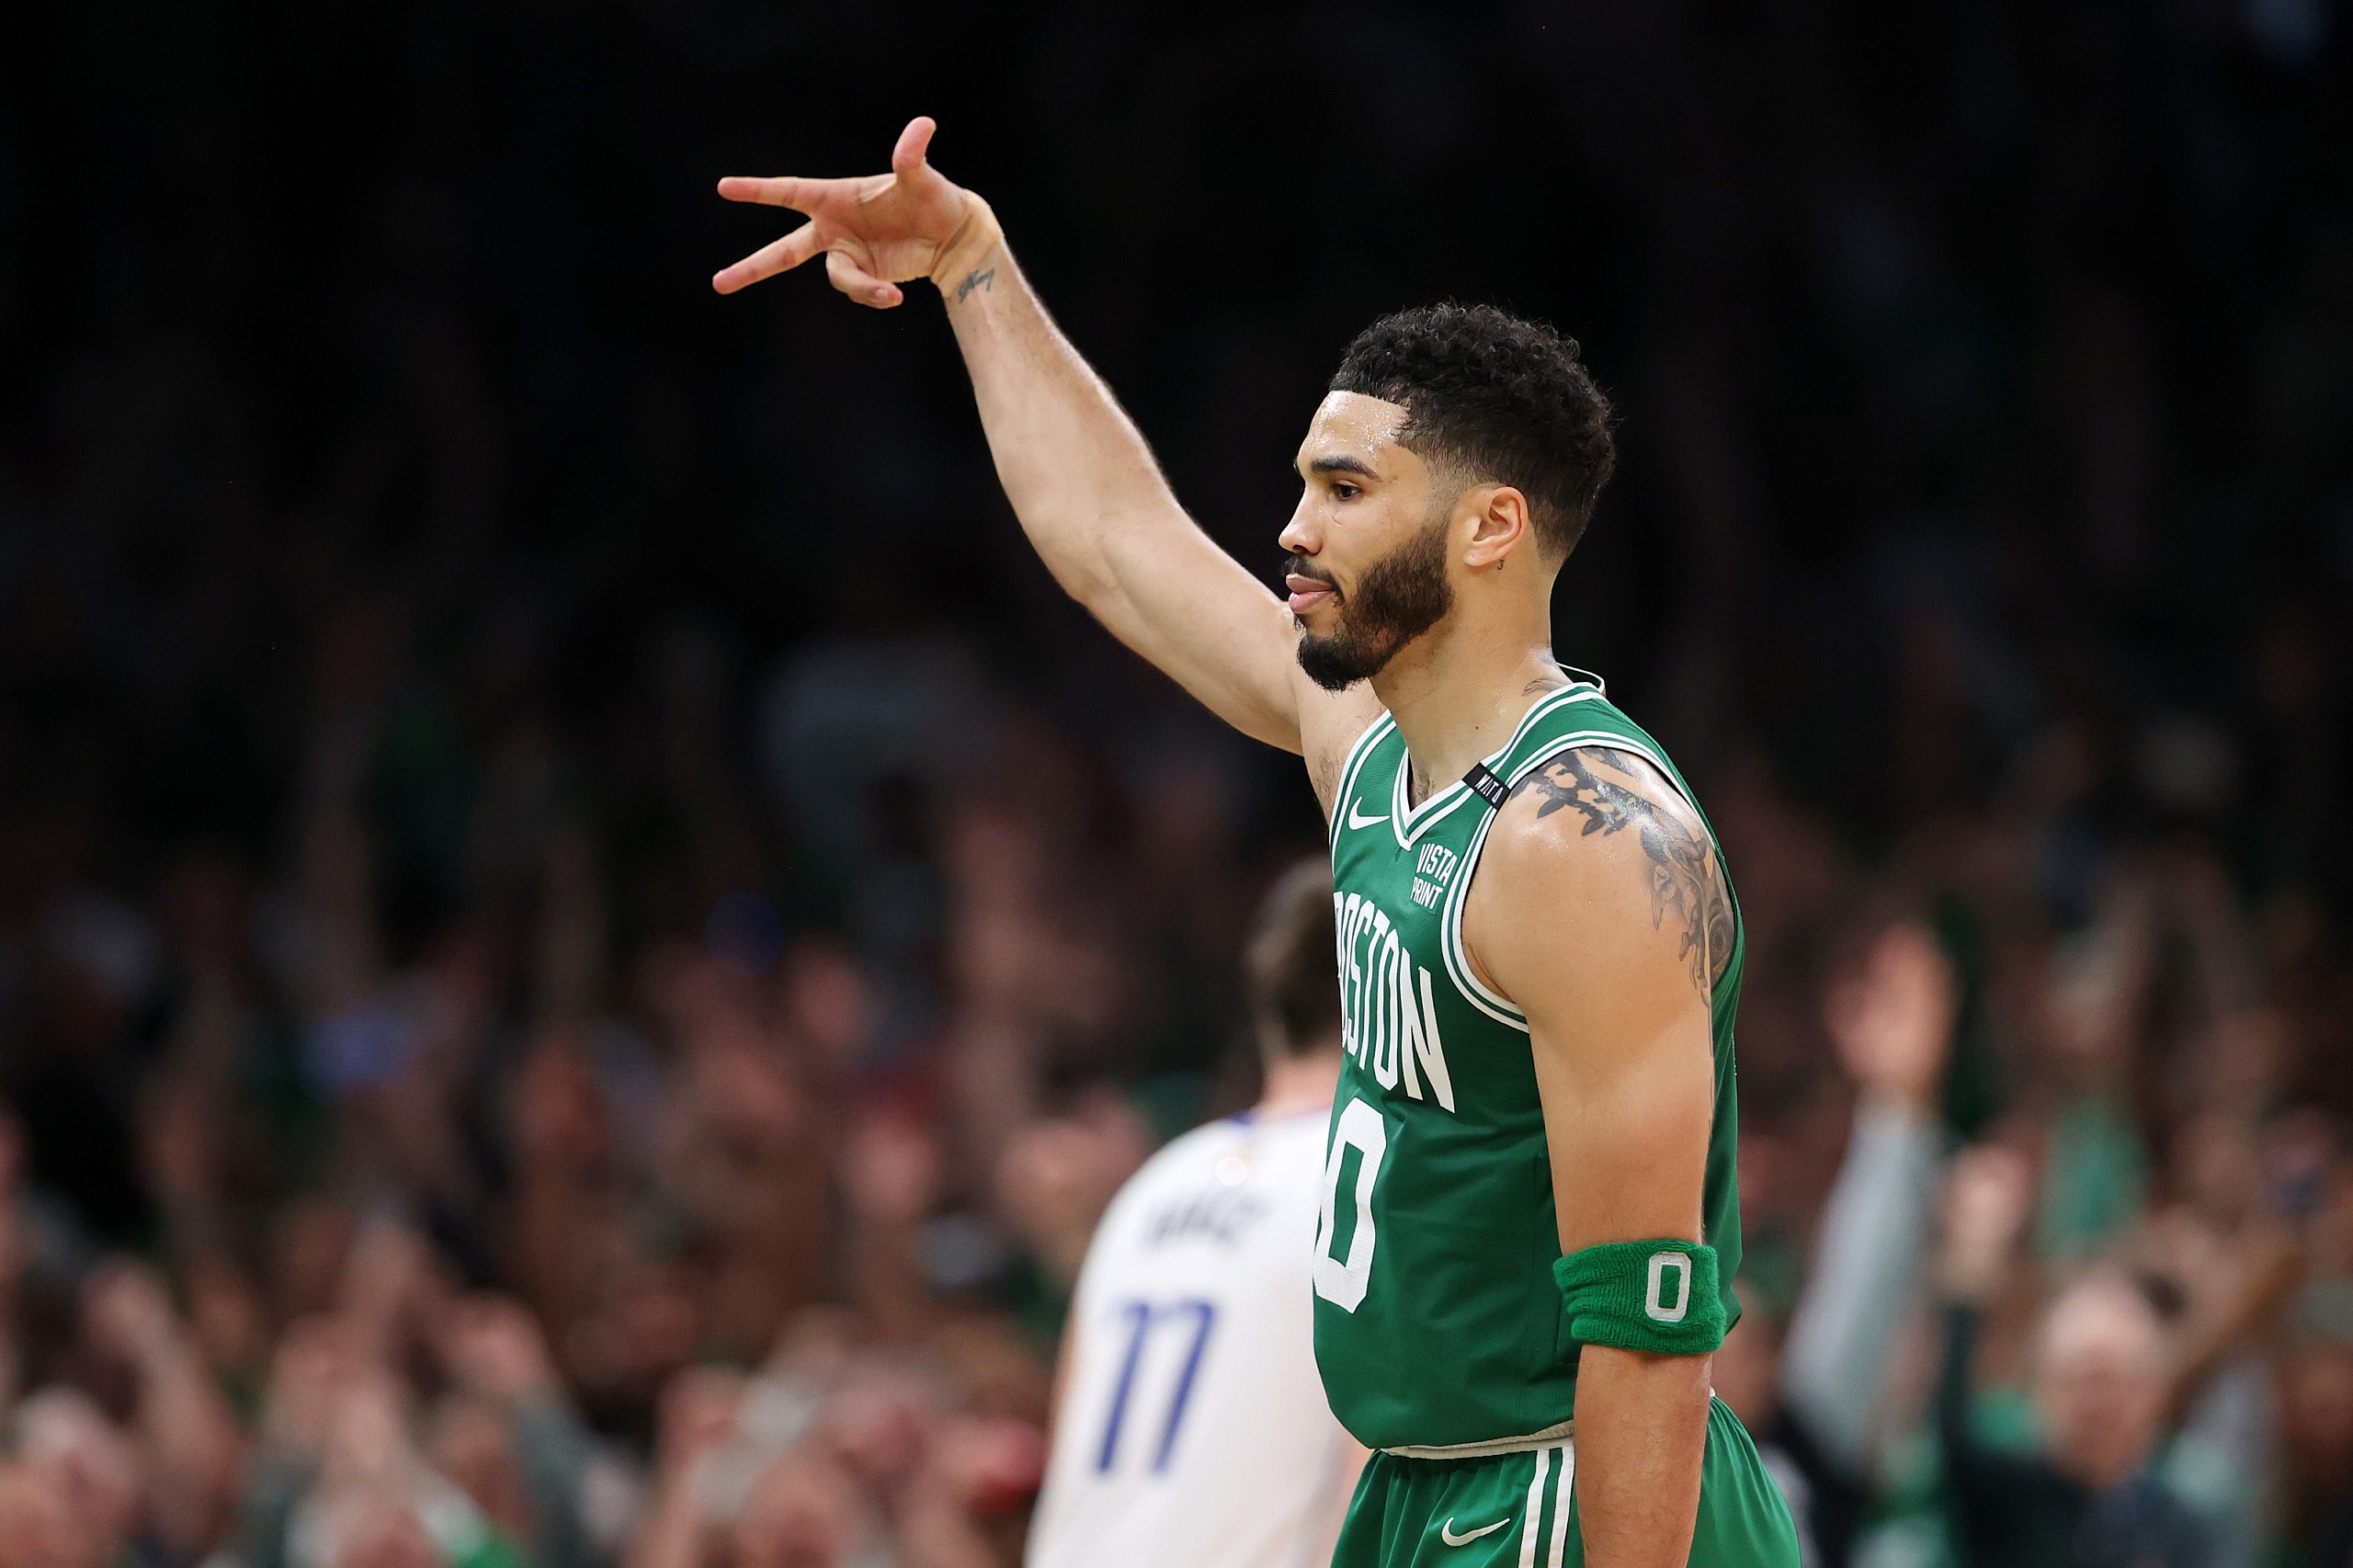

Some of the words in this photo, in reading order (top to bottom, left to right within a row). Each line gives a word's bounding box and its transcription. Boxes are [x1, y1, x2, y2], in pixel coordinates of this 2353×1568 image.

[1410, 876, 1444, 910] PRINT
[1416, 843, 1458, 887] VISTA
[1312, 1096, 1387, 1314] 0
[1645, 1251, 1692, 1323] 0
